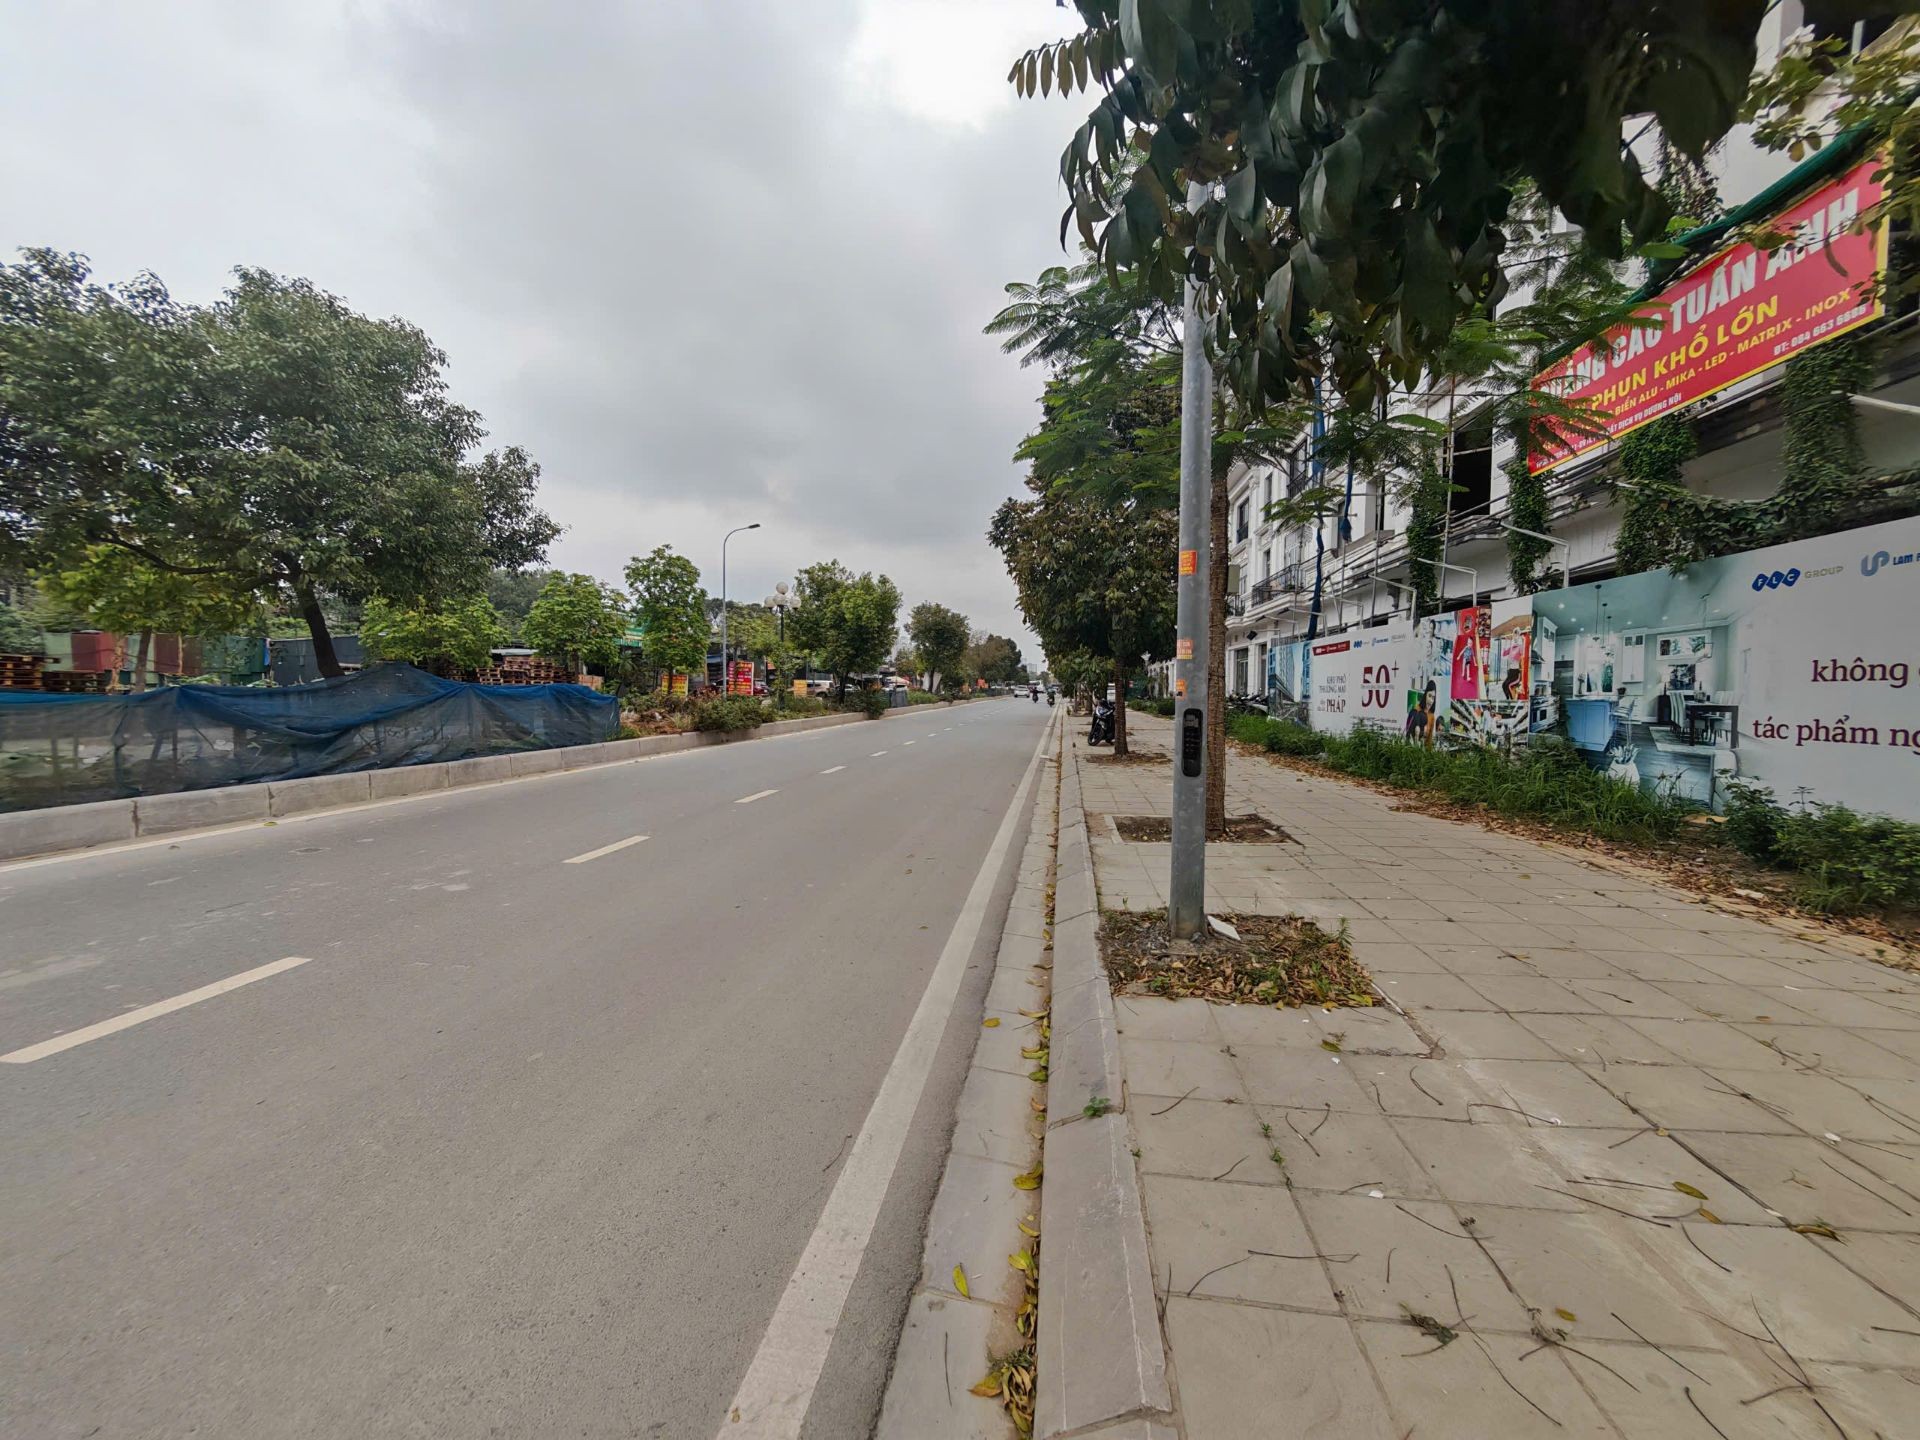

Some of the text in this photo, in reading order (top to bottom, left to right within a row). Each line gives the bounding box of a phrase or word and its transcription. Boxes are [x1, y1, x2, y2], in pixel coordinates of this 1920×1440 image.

[1591, 295, 1778, 411] PHUN KHỔ LỚN
[1639, 386, 1658, 404] ALU
[1665, 368, 1696, 389] MIKA
[1705, 351, 1727, 371] LED
[1737, 317, 1792, 354] MATRIX
[1805, 287, 1850, 320] INOX
[1753, 565, 1844, 591] FLC GROUP
[1811, 657, 1908, 688] không
[1753, 716, 1789, 739] tác
[1796, 715, 1880, 746] phẩm
